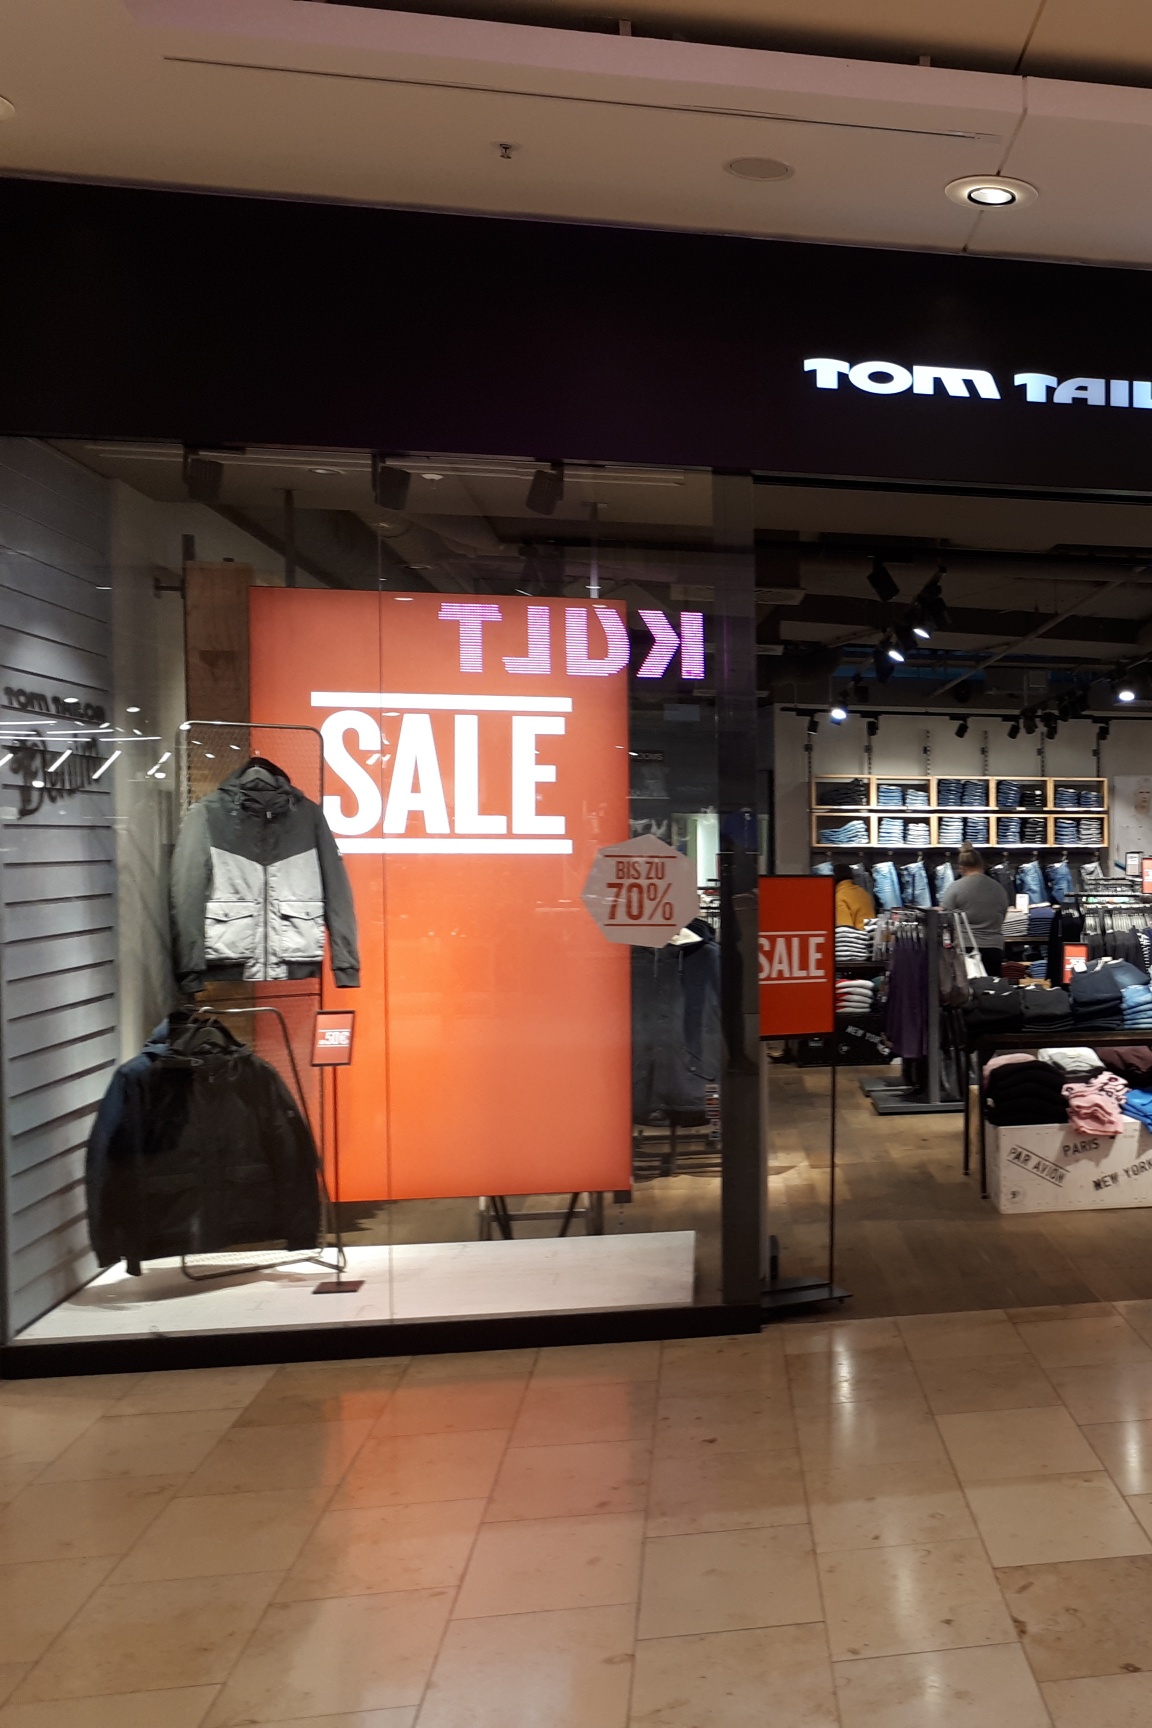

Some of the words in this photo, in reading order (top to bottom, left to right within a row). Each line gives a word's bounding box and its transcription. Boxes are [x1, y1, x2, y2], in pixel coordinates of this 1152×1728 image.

[803, 357, 1000, 400] TOM
[321, 710, 566, 837] SALE
[615, 861, 641, 880] BIS
[645, 861, 665, 880] ZU
[606, 882, 674, 921] 70%
[759, 937, 826, 979] SALE
[1006, 1147, 1032, 1167] PAR
[1031, 1160, 1067, 1184] AVION
[1062, 1137, 1100, 1157] PARIS
[1092, 1167, 1120, 1191] NEW
